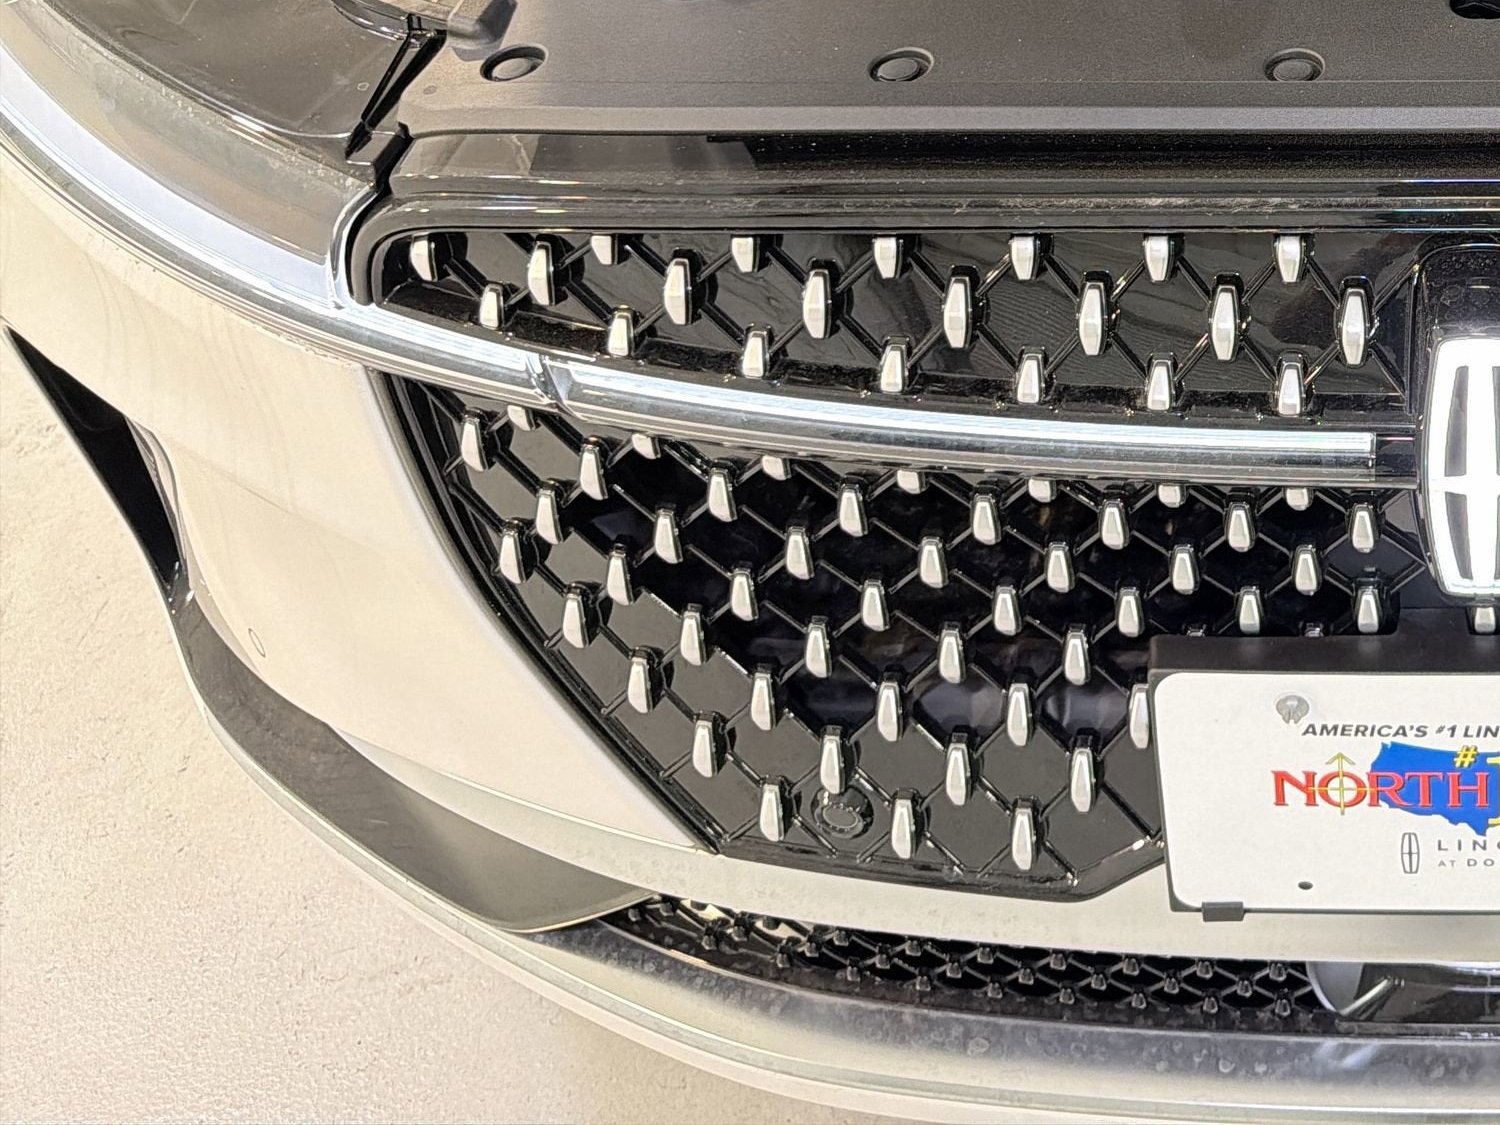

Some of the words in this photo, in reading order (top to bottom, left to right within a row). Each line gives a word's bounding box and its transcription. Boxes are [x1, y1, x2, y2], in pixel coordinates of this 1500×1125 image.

[1301, 723, 1429, 738] AMERICA'S
[1435, 724, 1459, 738] #1
[1270, 769, 1490, 808] NORTH
[1437, 859, 1457, 868] AT
